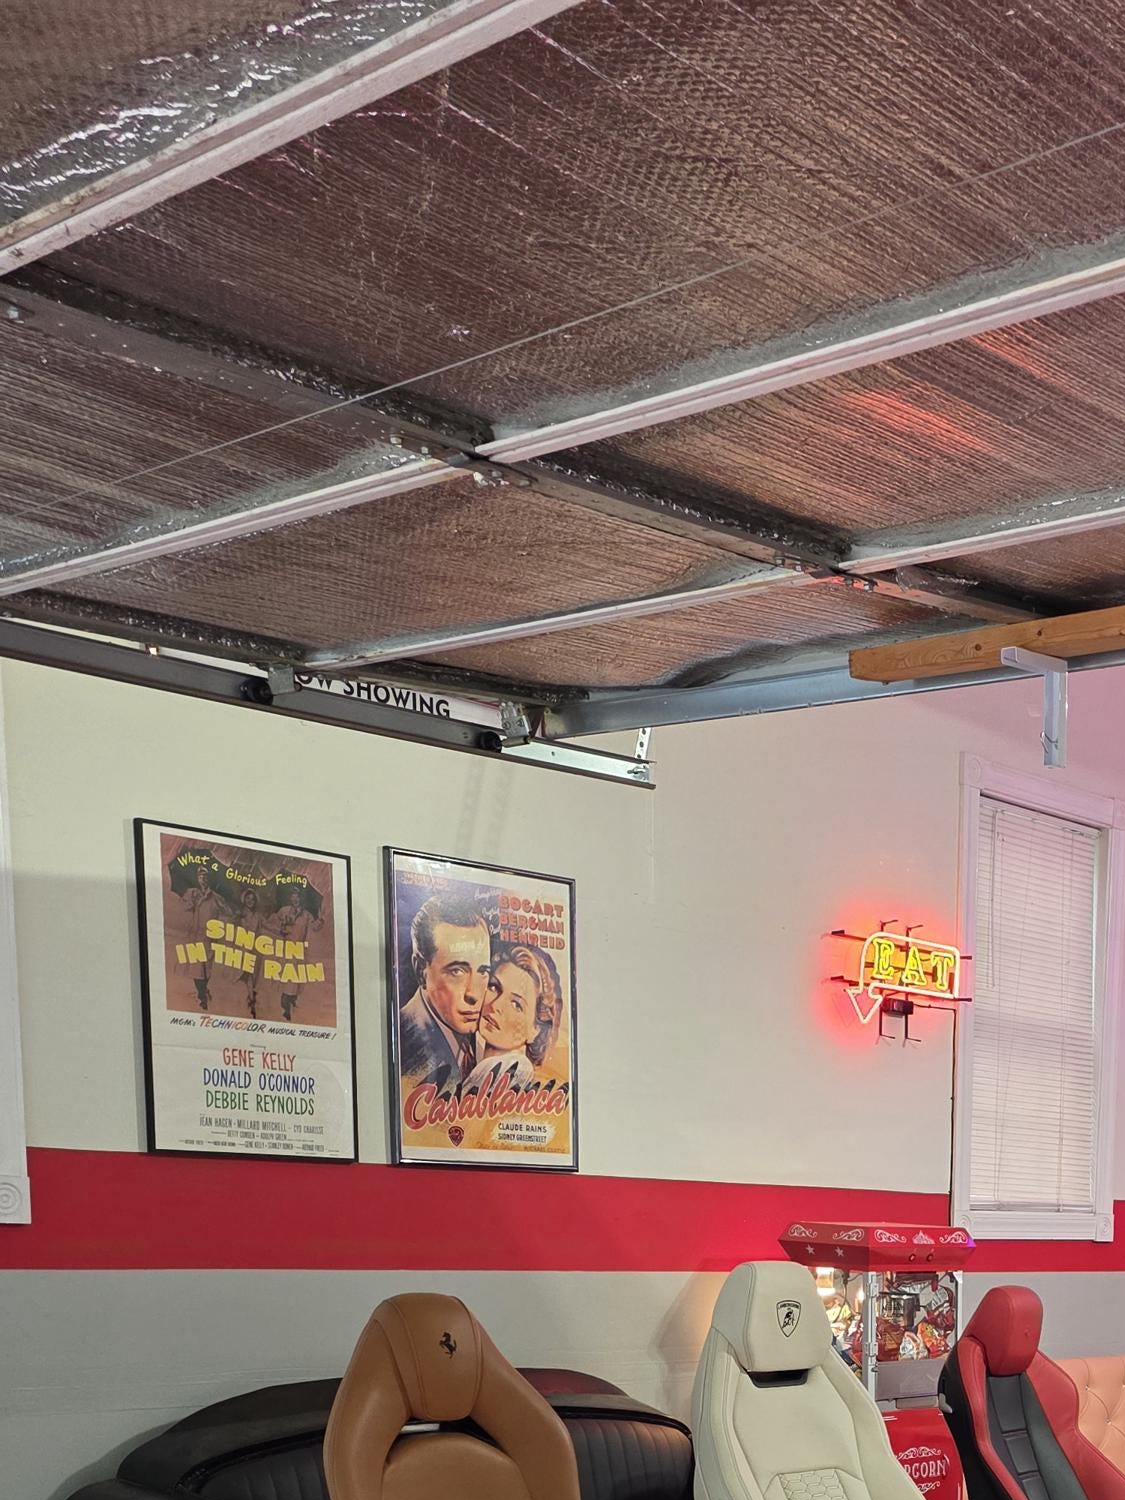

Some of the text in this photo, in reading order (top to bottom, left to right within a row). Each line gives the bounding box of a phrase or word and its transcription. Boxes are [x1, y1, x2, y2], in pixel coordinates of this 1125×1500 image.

[295, 674, 450, 718] OW SHOWING
[177, 852, 307, 888] What a Glorious Feeling
[500, 895, 564, 918] BOGART
[500, 911, 564, 935] BERGMAN
[206, 919, 309, 960] SINGIN'
[500, 928, 565, 950] HENREID
[175, 942, 325, 984] IN THE RAIN
[872, 937, 954, 991] EAT
[200, 1015, 266, 1034] TECHNICOLOR
[267, 1028, 297, 1037] MUSICAL
[223, 1047, 296, 1073] GENE KELLY
[203, 1068, 315, 1095] DONALD O'CONNOR
[206, 1089, 315, 1116] DEBBIE REYNOLDS
[403, 1071, 565, 1131] Casablanca
[237, 1119, 260, 1131] MILLARD
[262, 1121, 286, 1132] MITCHELL
[498, 1122, 547, 1133] CLAUDE RAINS
[904, 1459, 947, 1479] PCORN
